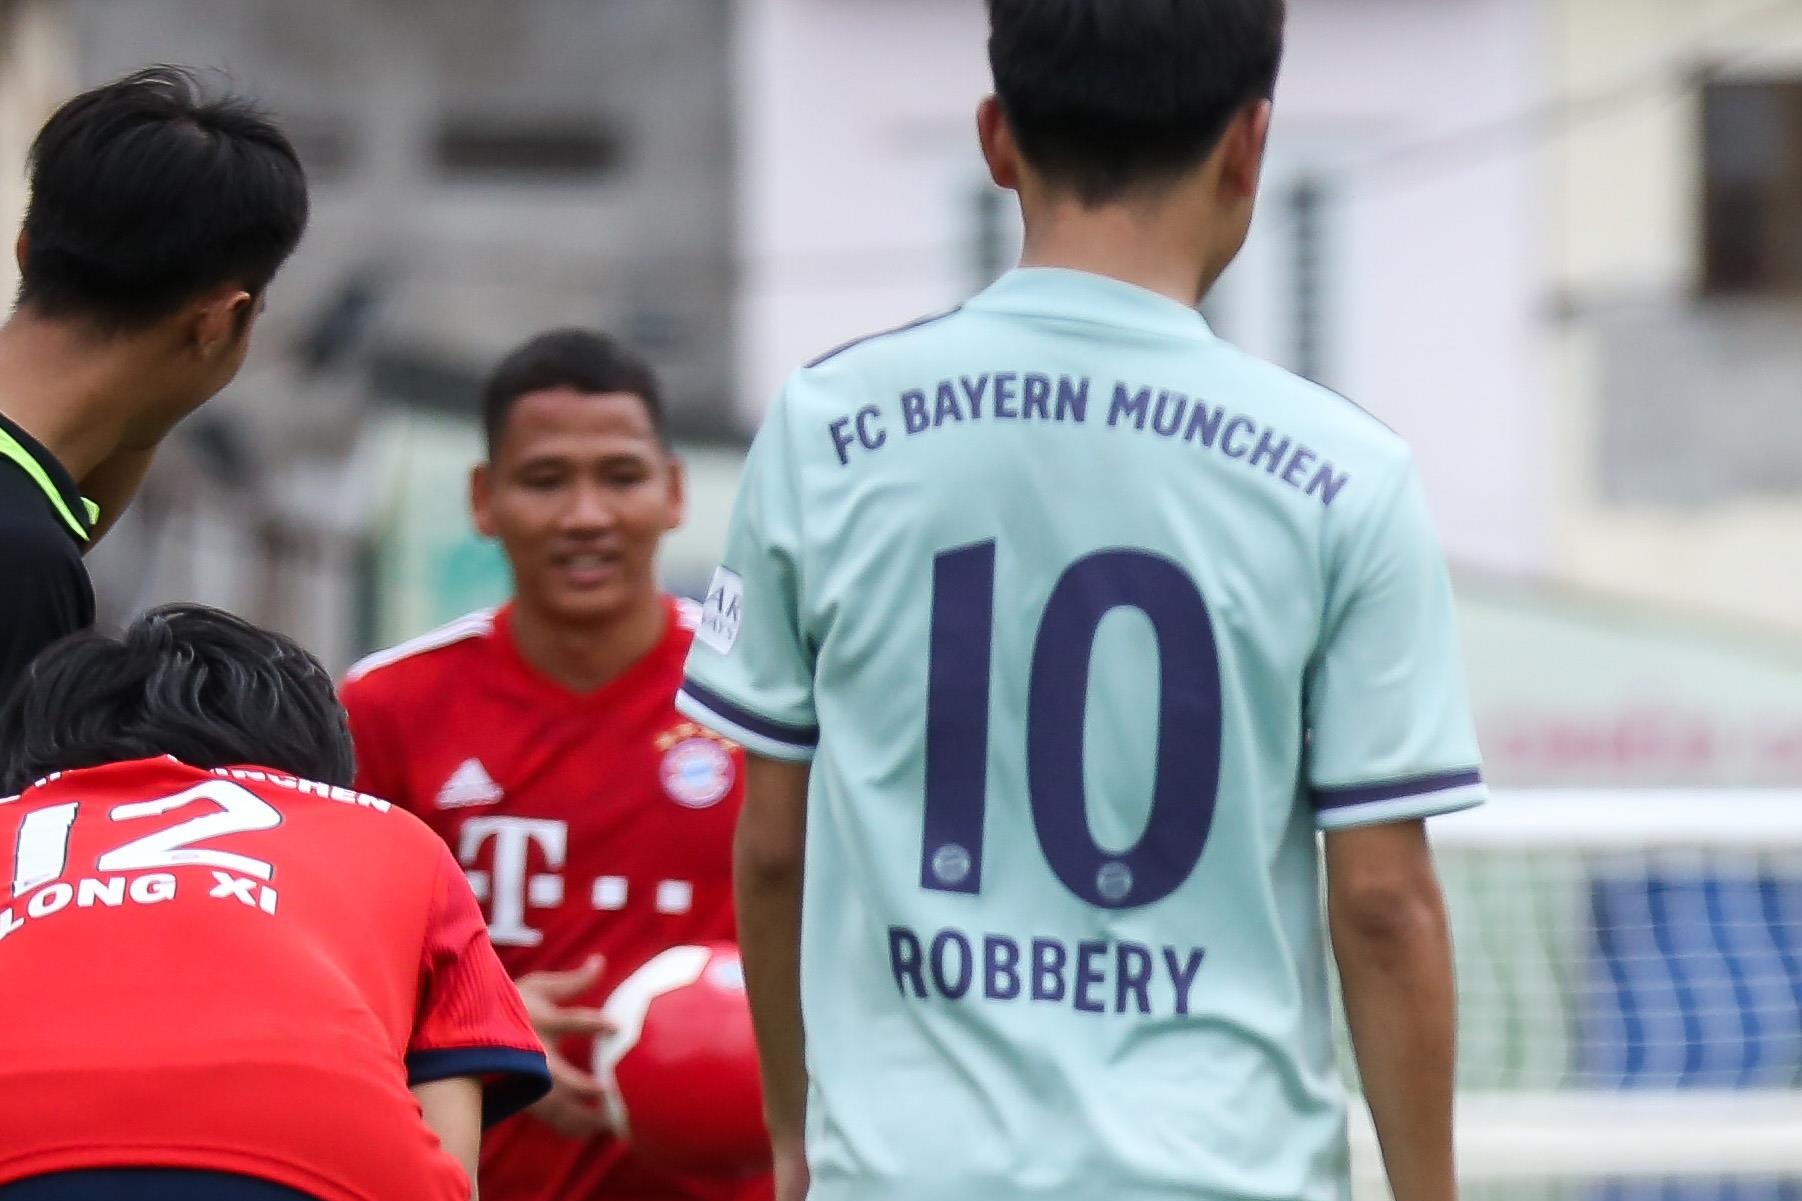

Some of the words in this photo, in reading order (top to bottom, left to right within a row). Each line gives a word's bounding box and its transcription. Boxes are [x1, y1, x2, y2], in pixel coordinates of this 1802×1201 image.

[829, 404, 887, 466] FC
[900, 371, 1090, 436] BAYERN
[920, 537, 1222, 910] 10
[13, 779, 282, 898] 12
[209, 870, 278, 916] XI
[887, 923, 1206, 1016] ROBBERY
